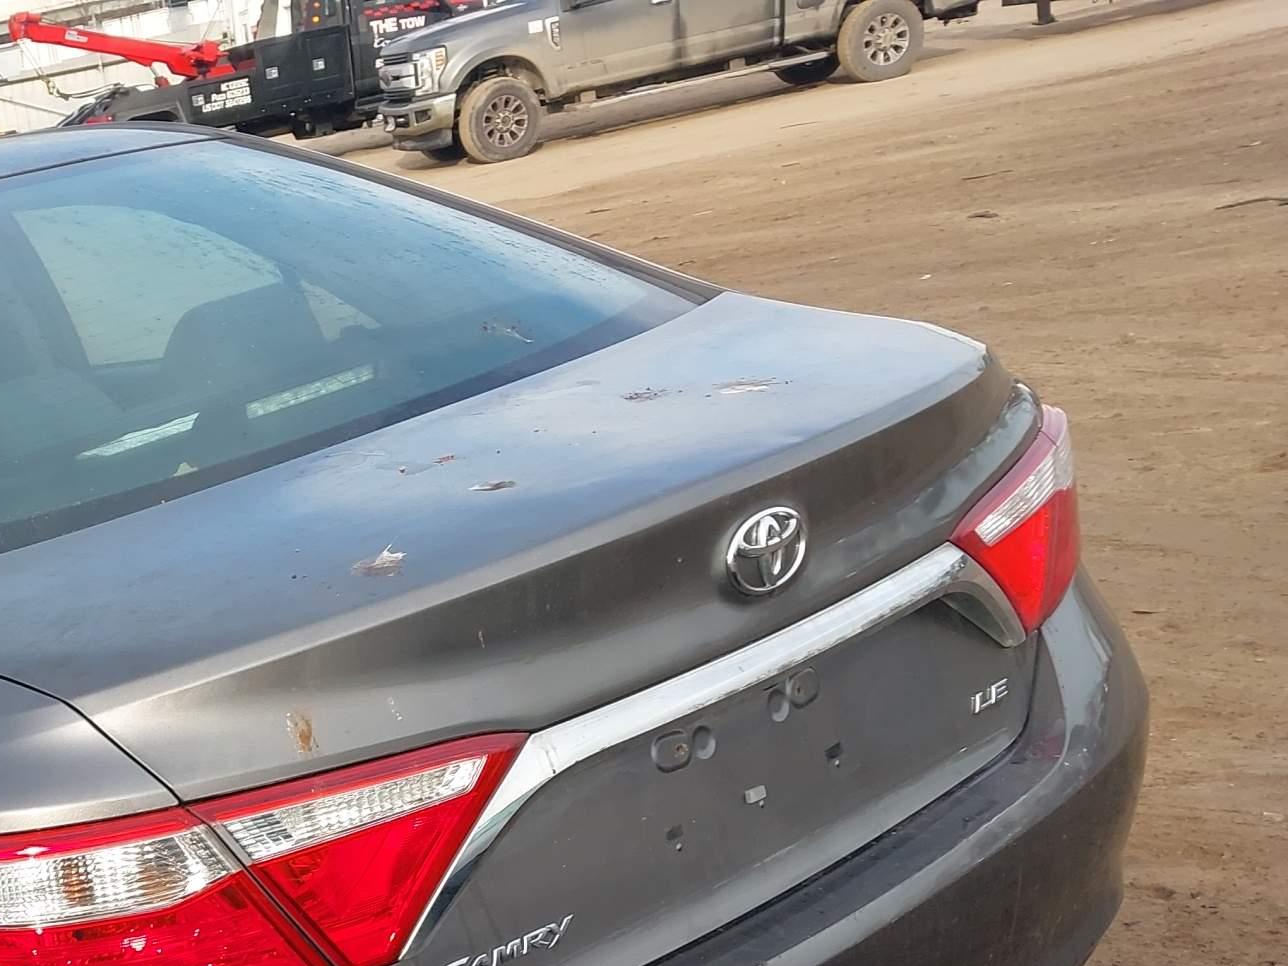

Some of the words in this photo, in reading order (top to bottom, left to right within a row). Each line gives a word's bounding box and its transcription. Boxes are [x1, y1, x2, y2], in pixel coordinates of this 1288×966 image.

[369, 17, 398, 34] THE
[399, 15, 425, 30] TOW
[970, 677, 1009, 714] LE
